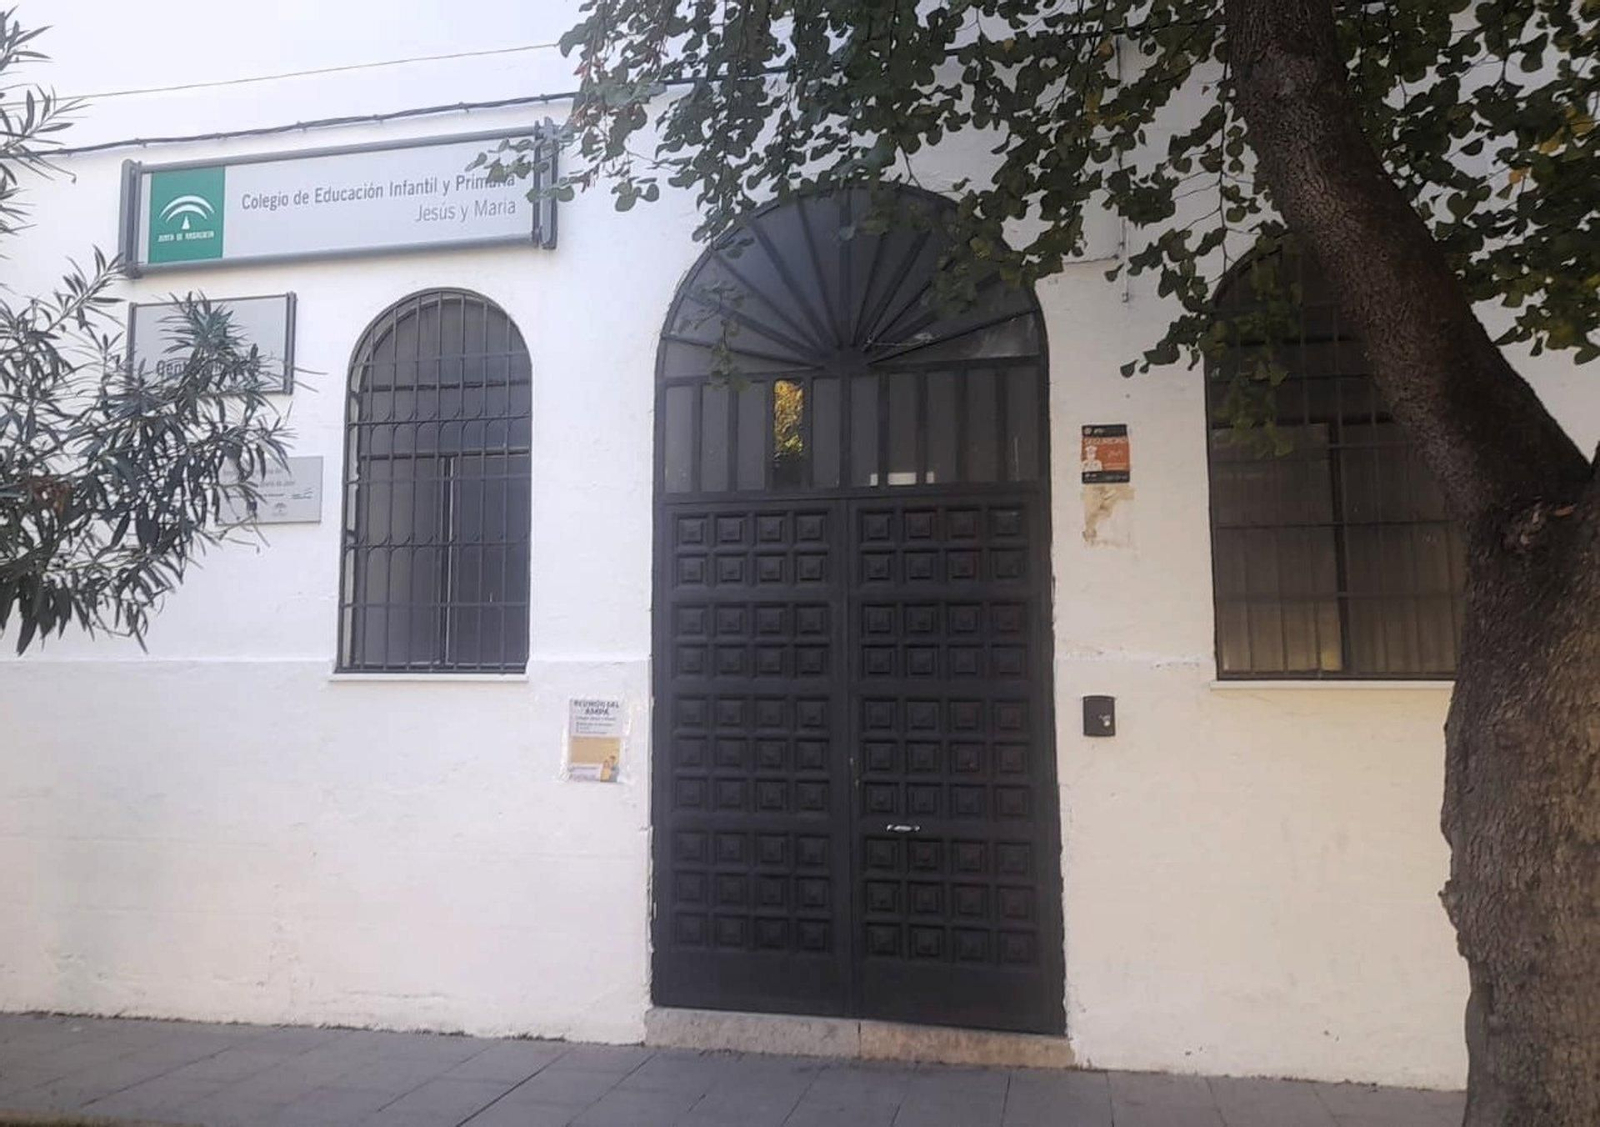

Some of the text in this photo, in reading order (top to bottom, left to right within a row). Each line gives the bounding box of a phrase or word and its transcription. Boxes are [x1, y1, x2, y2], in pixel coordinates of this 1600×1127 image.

[242, 193, 289, 211] Colegio
[294, 190, 309, 205] de
[315, 183, 383, 203] Educación
[389, 177, 438, 197] Infantil
[443, 180, 451, 197] y
[415, 202, 455, 222] Jesús
[461, 205, 470, 223] y
